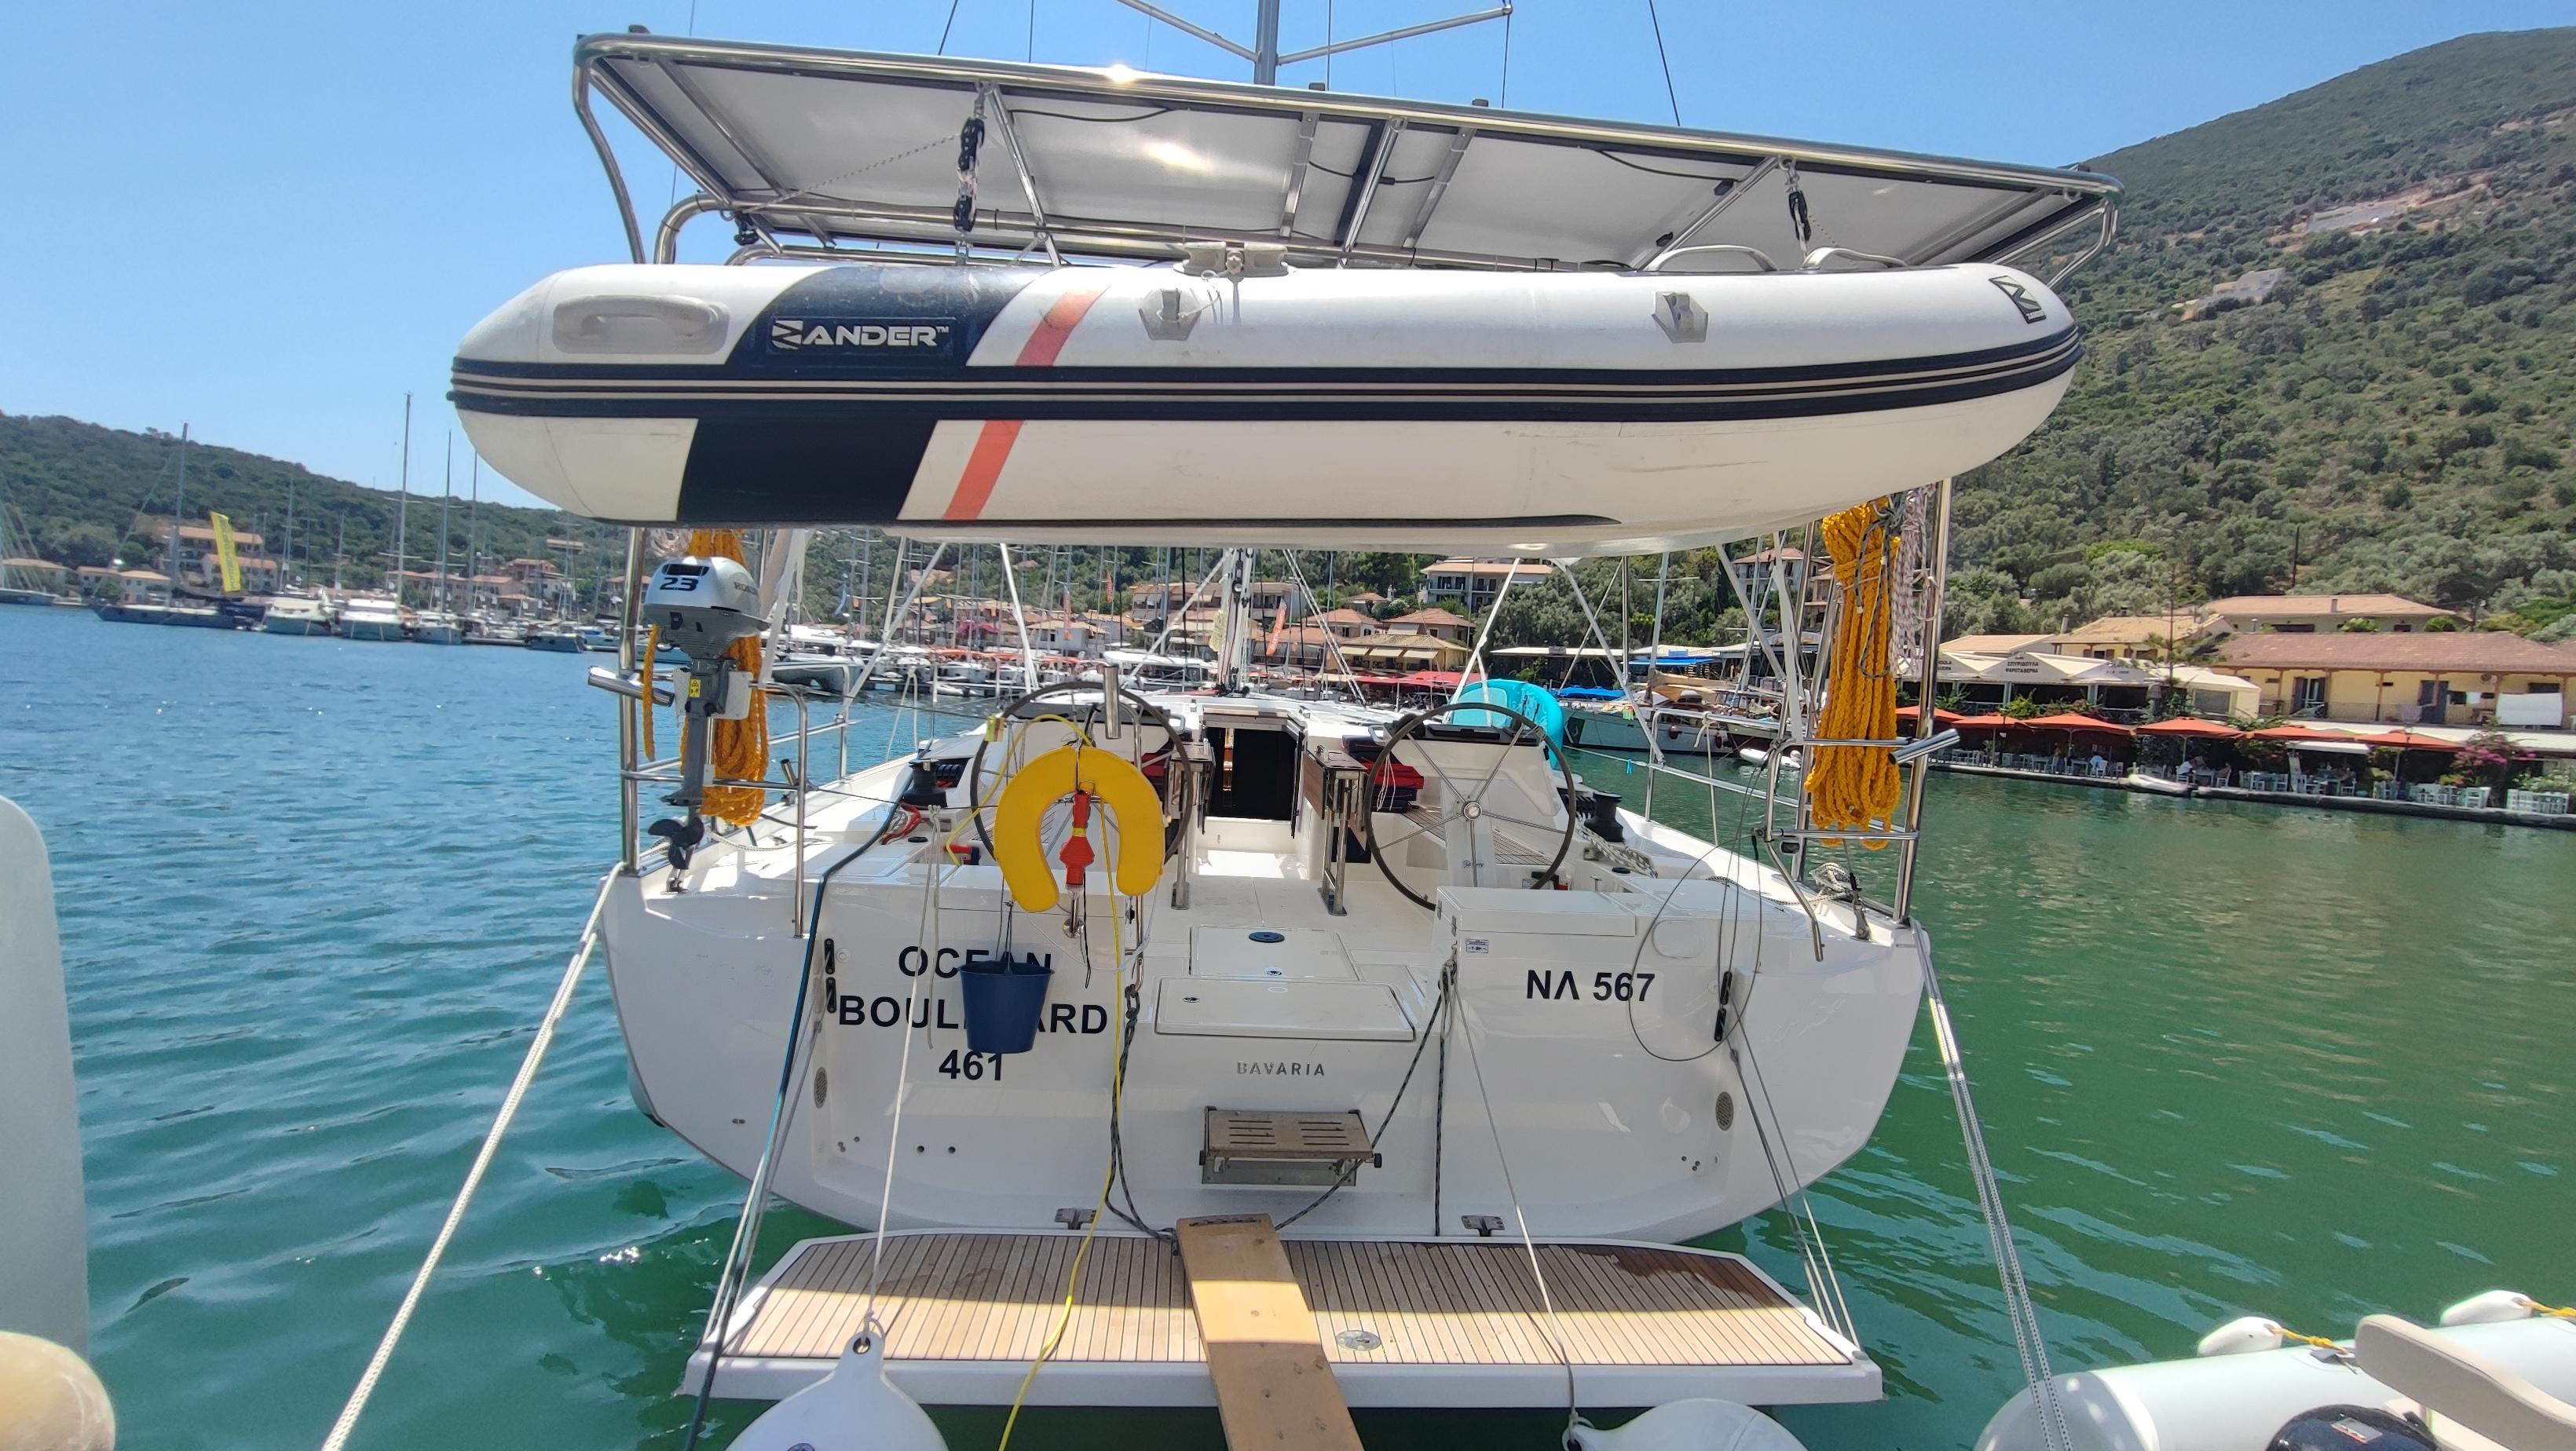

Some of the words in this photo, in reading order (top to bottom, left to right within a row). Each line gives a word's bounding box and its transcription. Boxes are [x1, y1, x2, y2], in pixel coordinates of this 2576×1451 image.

[1593, 972, 1656, 1001] 567
[839, 995, 1107, 1035] BOULRD
[939, 1049, 1004, 1082] 461
[1236, 1062, 1324, 1076] BAVARIA
